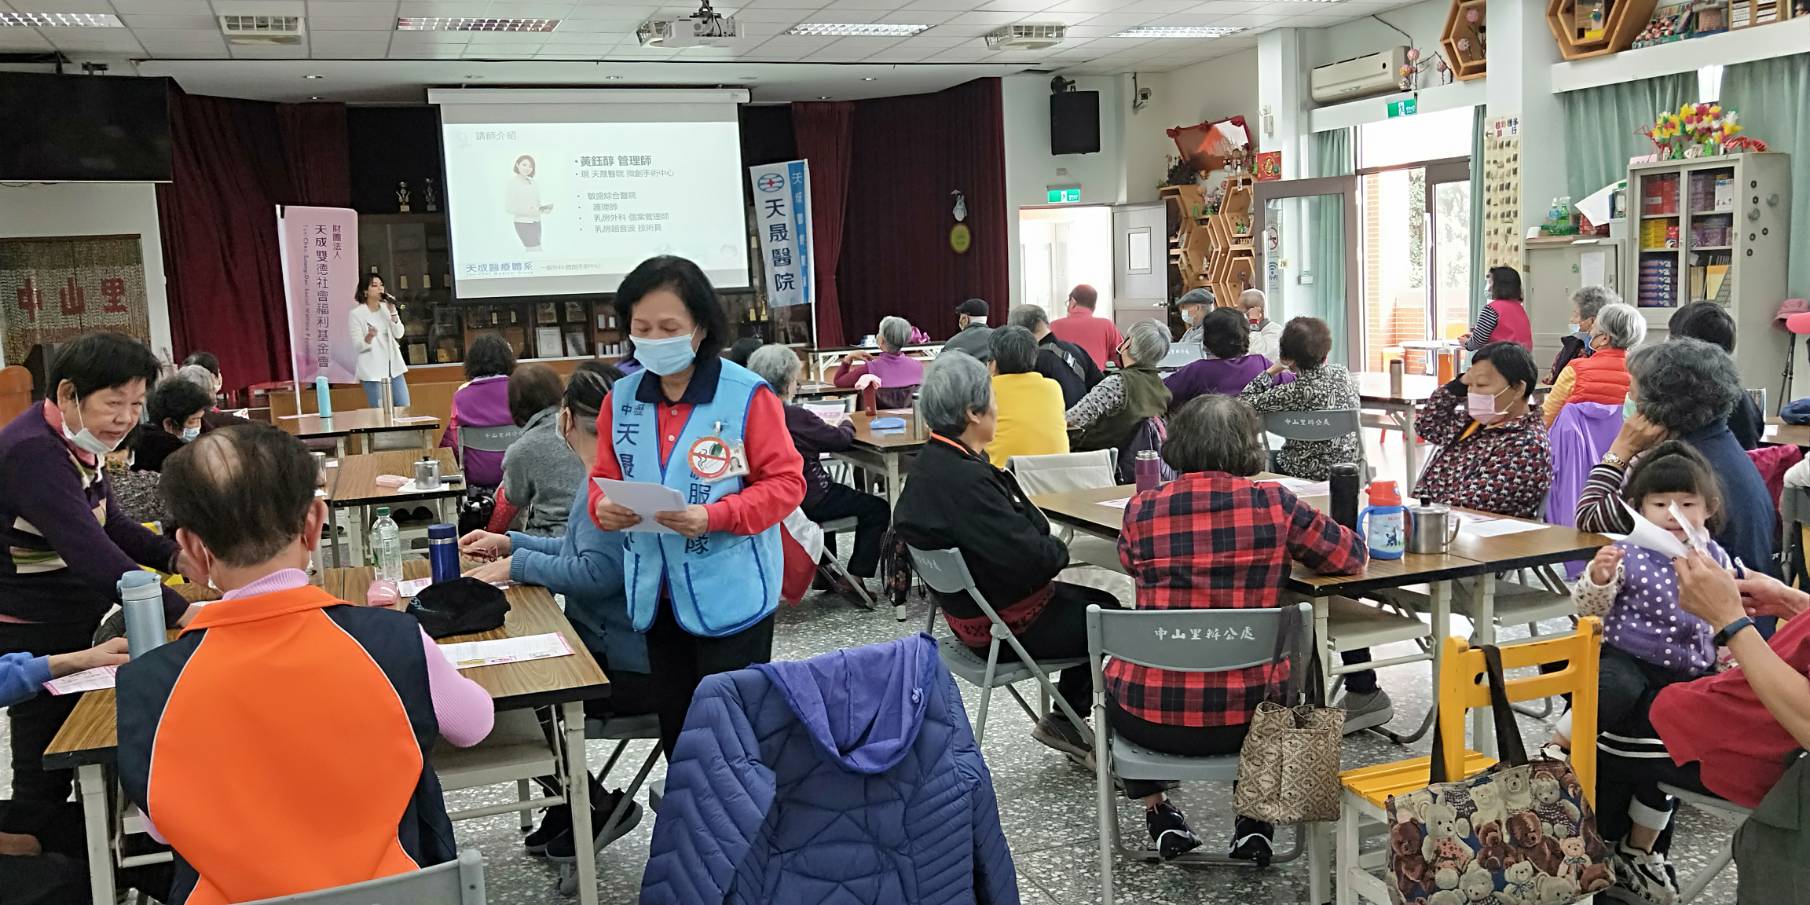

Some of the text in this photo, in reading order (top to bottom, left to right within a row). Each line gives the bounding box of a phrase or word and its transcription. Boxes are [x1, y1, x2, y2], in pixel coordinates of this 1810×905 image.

[617, 155, 652, 166] 管理師
[765, 198, 795, 291] 天晟醫院
[16, 277, 129, 321] 中山里
[315, 224, 329, 368] 天成雙德社會福利基金會
[1154, 626, 1256, 641] 中山里辦公處
